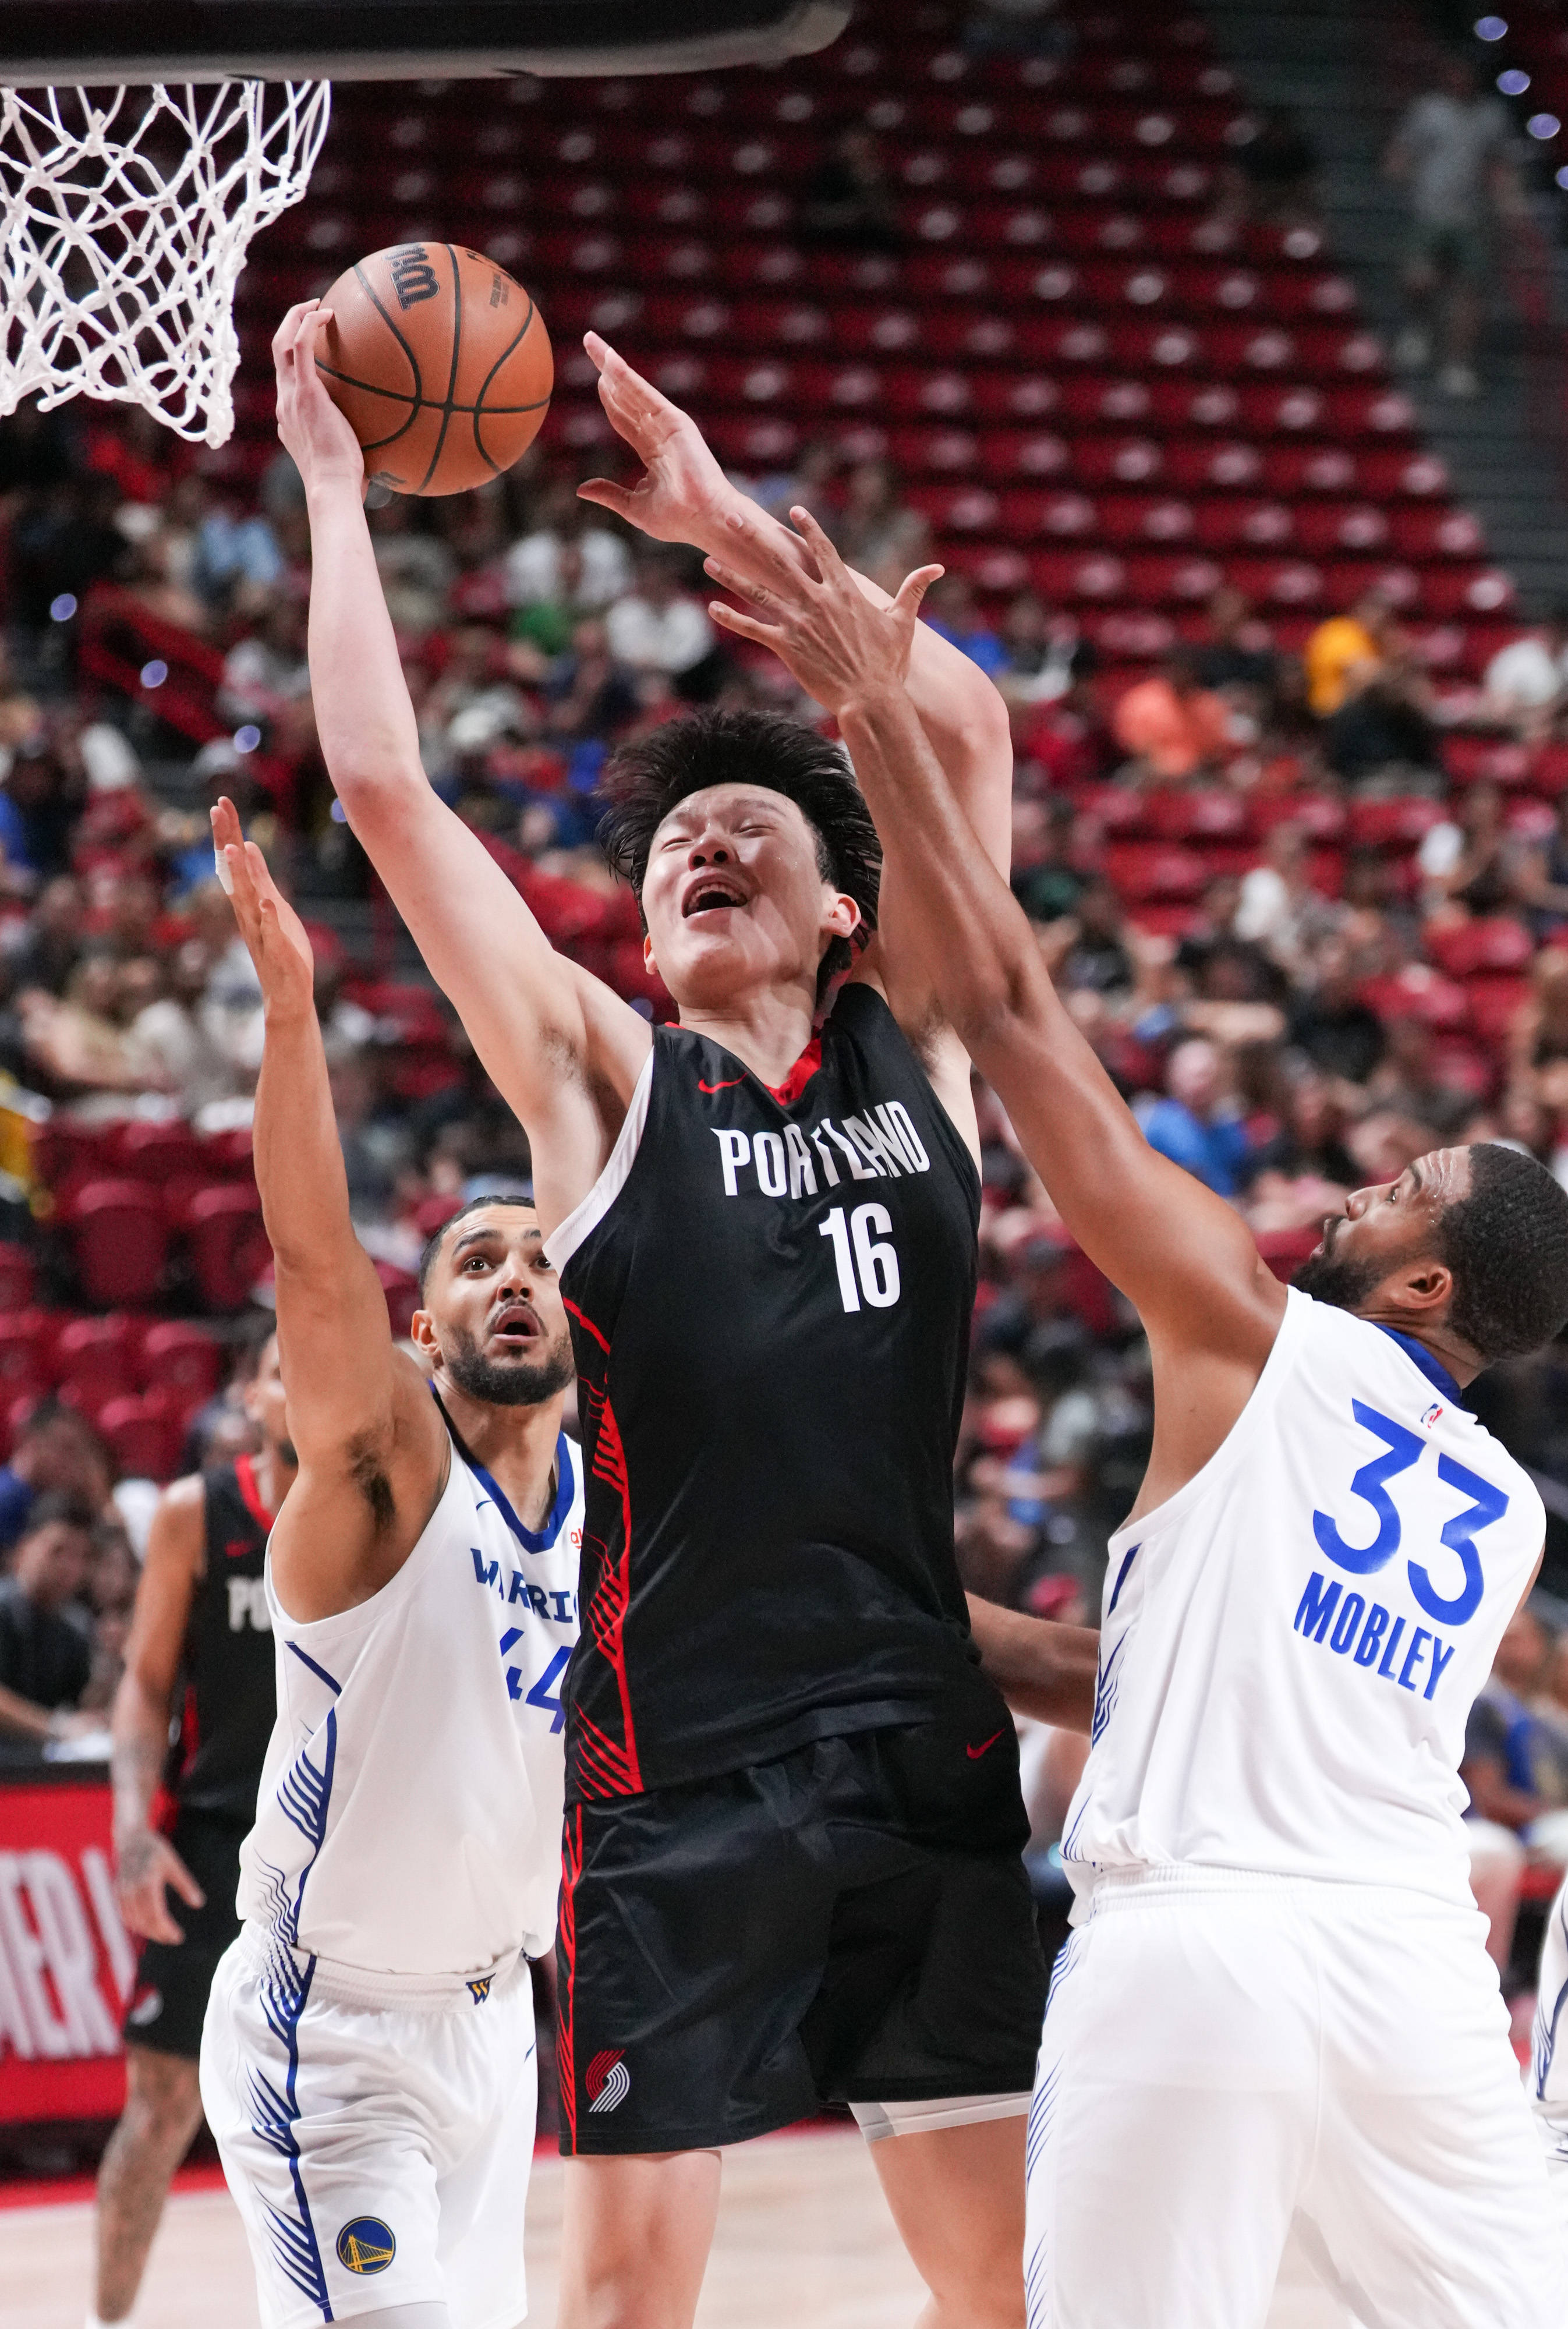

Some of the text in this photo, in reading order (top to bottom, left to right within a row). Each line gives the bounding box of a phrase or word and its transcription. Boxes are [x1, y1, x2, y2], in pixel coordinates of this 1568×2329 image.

[710, 1100, 930, 1199] PORTLAND
[818, 1202, 901, 1313] 16
[1312, 1397, 1510, 1626] 33
[470, 1548, 579, 1623] WRRI
[1293, 1571, 1456, 1701] MOBLEY
